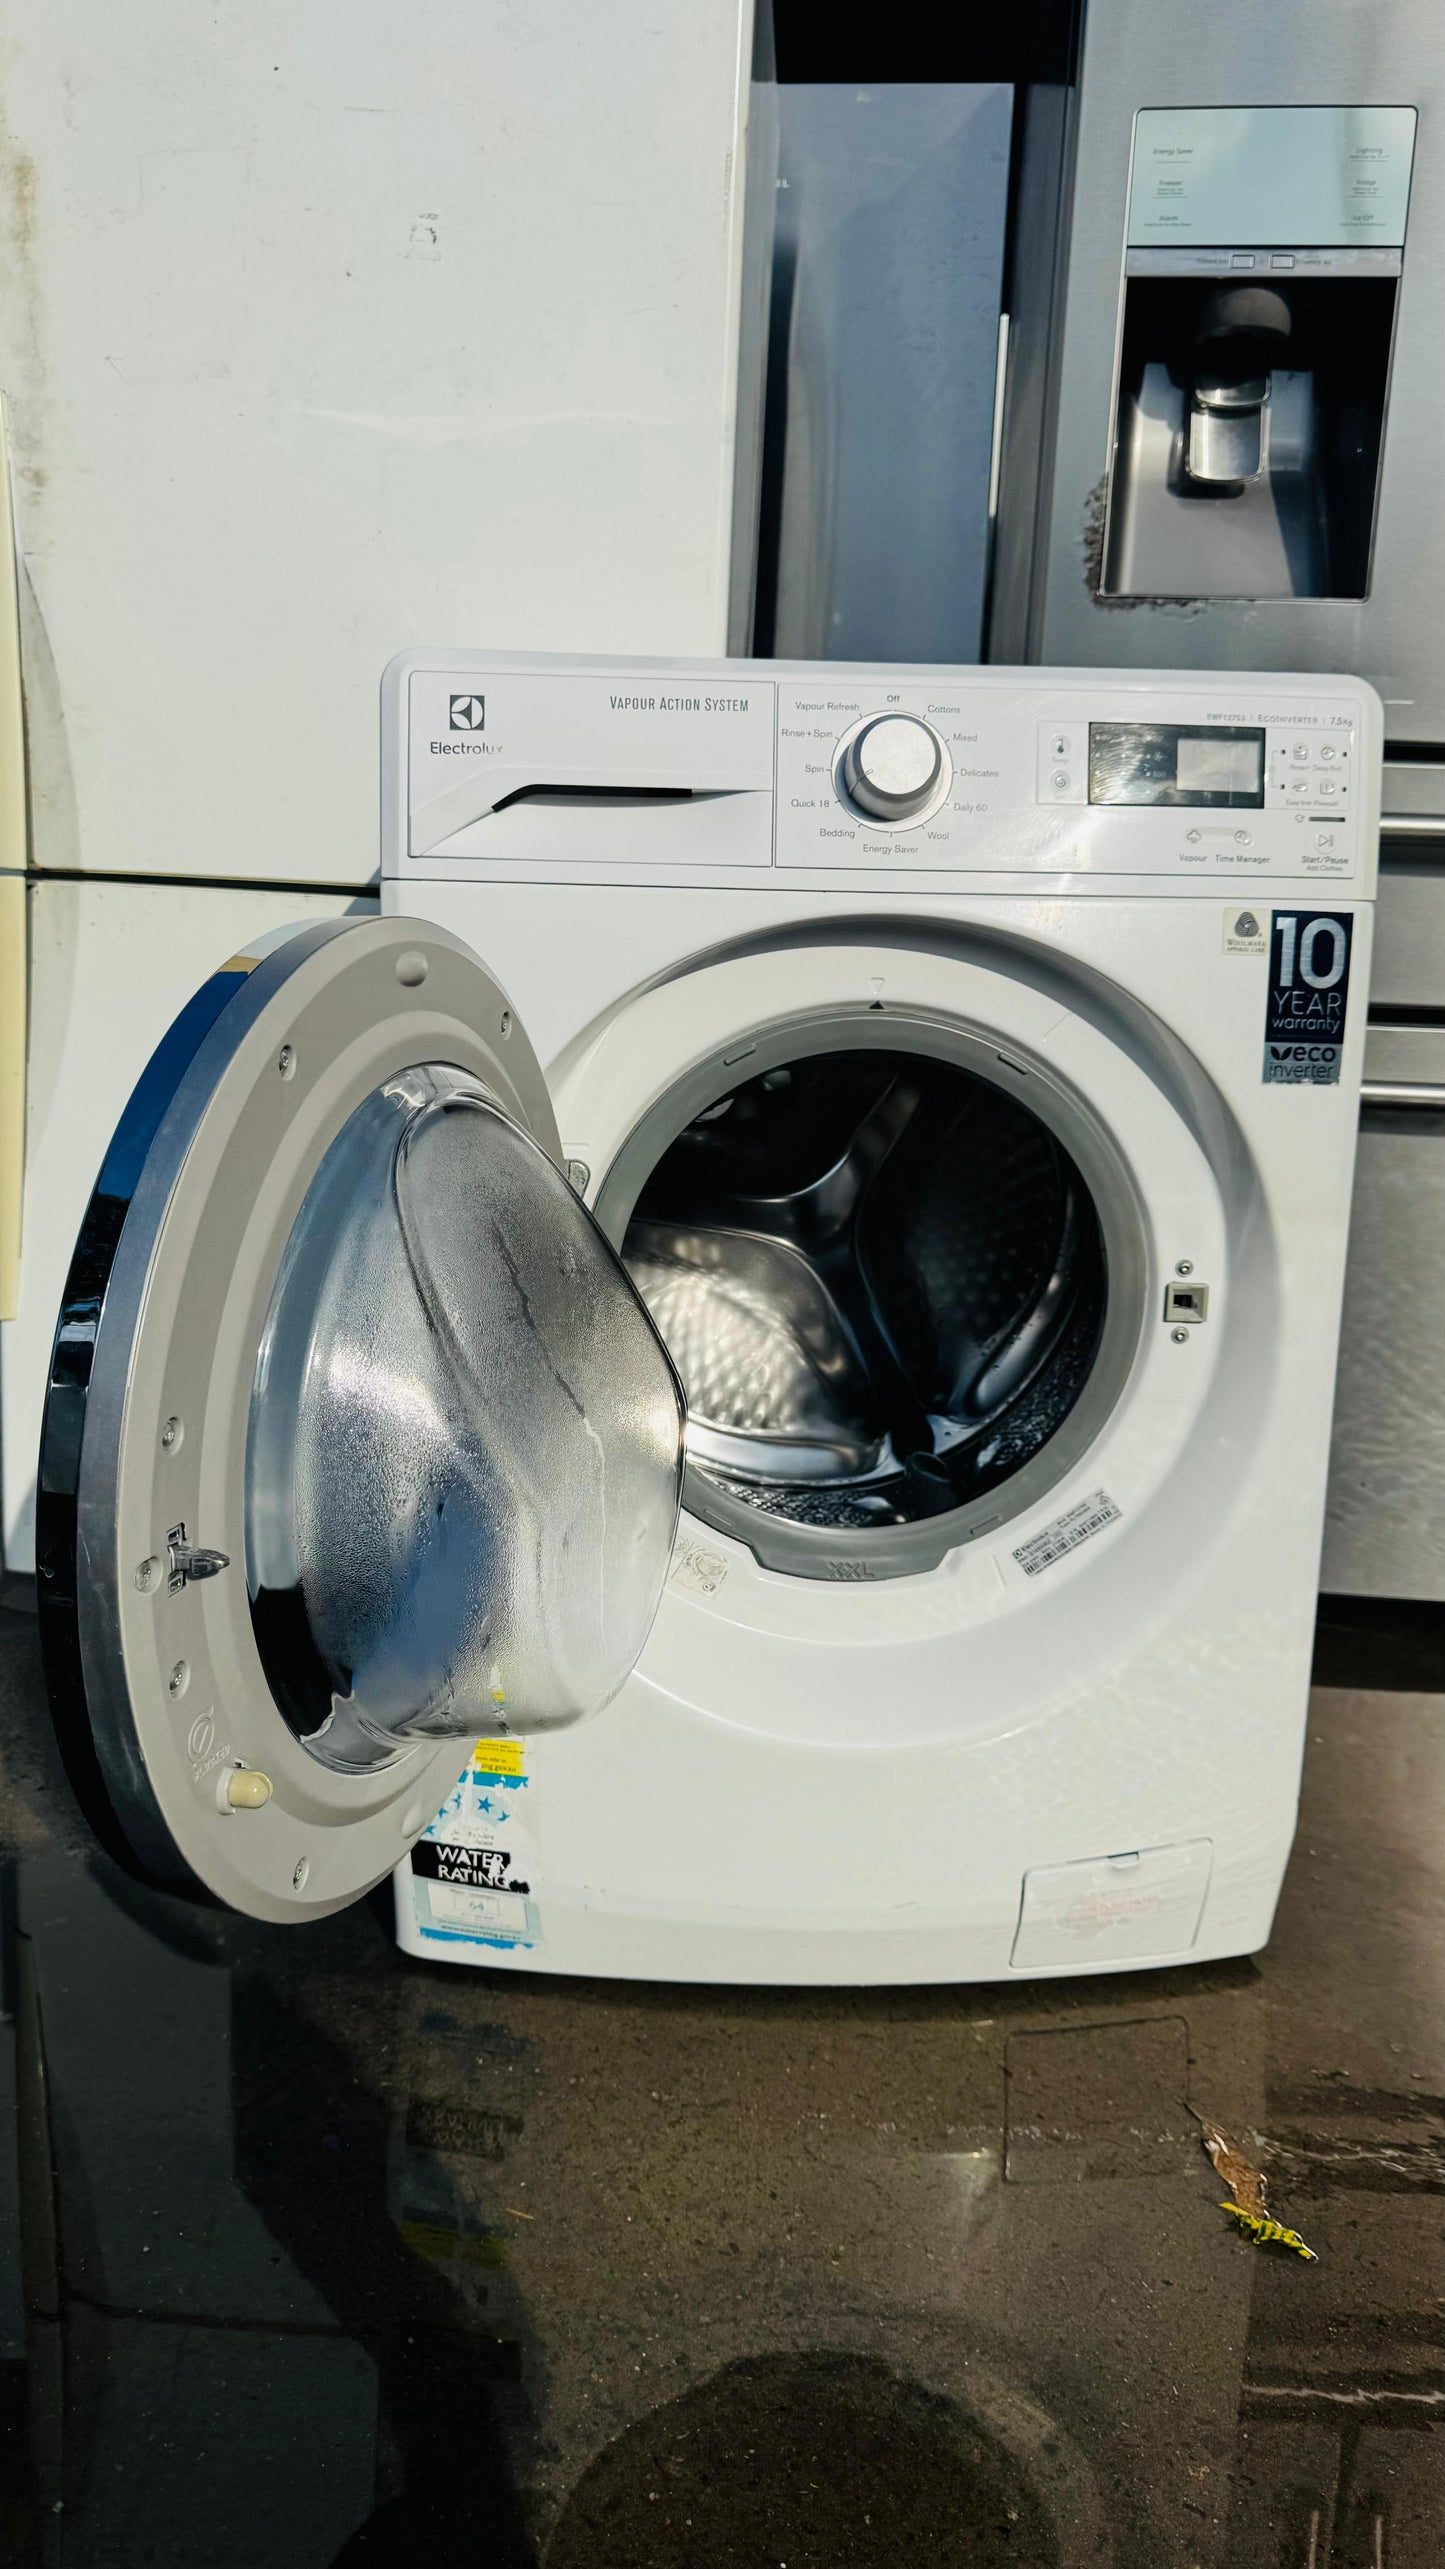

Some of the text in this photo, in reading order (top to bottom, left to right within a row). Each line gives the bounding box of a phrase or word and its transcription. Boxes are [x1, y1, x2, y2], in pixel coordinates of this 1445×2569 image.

[610, 696, 749, 713] VAPOUR ACTION SYSTEM
[886, 694, 900, 703] Off
[795, 702, 860, 712] Vapour Refresh
[928, 704, 961, 714] Cottons
[781, 729, 806, 738] Rinse
[814, 729, 833, 740] Spin
[952, 733, 978, 742] Mixed
[430, 741, 503, 755] Electrolux
[804, 764, 824, 775] Spin
[960, 769, 999, 778] Delicates
[790, 798, 830, 808] Quick 18
[954, 802, 988, 814] Daily 60
[820, 828, 856, 840] Bedding
[928, 832, 950, 840] Wool
[862, 844, 919, 856] Energy Saver
[1178, 854, 1208, 864] Vapour
[1214, 854, 1270, 865] Time Manager
[1301, 855, 1349, 865] Start/Pause
[1276, 916, 1347, 990] 10
[1273, 990, 1342, 1016] YEAR
[1272, 1016, 1341, 1034] warranty
[1292, 1046, 1336, 1062] eco
[1269, 1062, 1334, 1078] inverter
[826, 1560, 876, 1579] XXL
[436, 1845, 504, 1870] WATER
[437, 1864, 508, 1888] RATING
